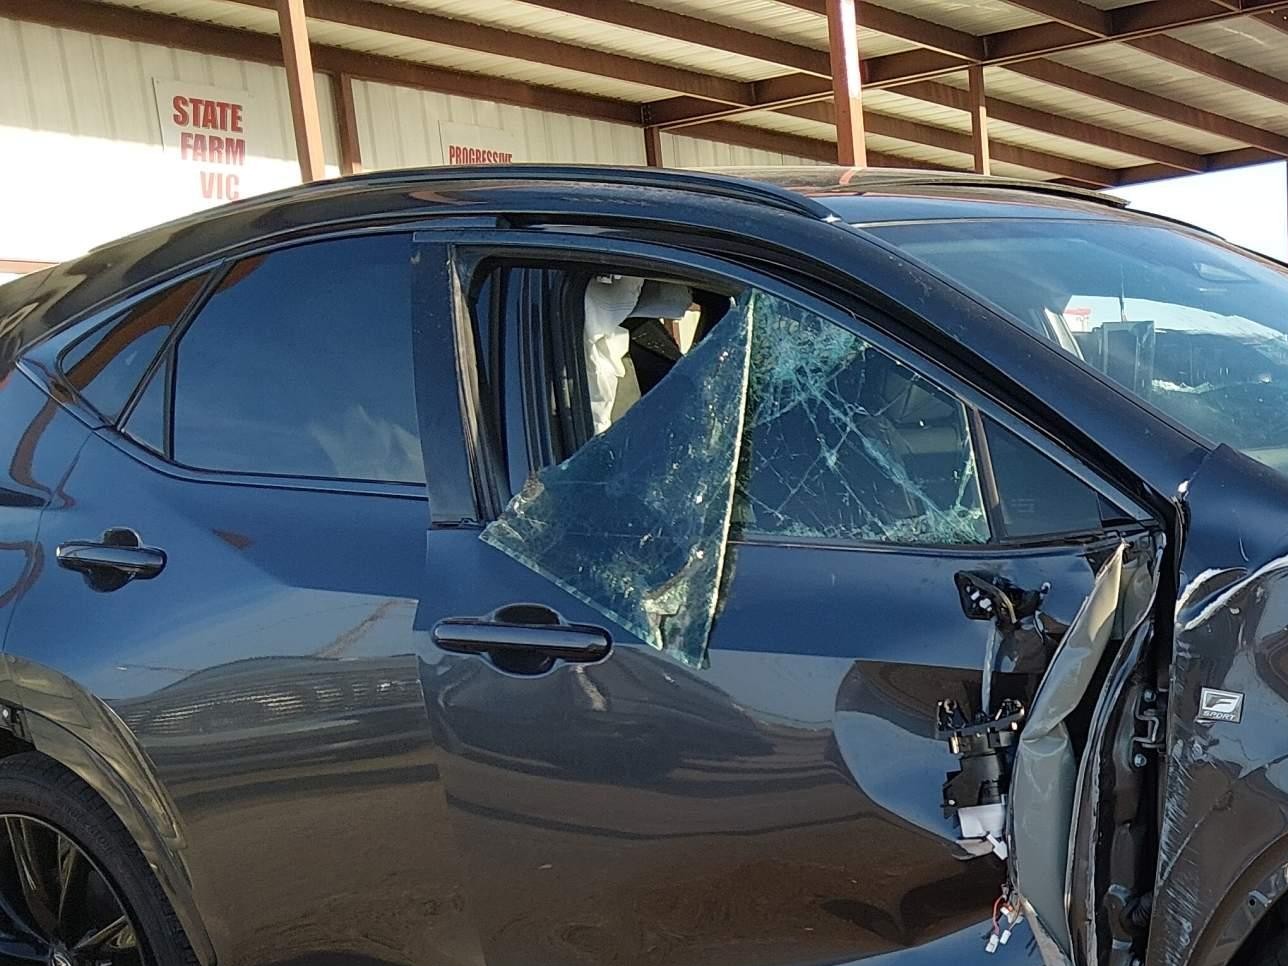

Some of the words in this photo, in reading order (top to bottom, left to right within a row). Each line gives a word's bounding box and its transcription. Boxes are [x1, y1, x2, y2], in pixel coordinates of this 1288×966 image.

[173, 95, 244, 133] STATE
[181, 132, 246, 166] FARM
[200, 171, 240, 201] VIC
[1203, 710, 1236, 721] SPORT
